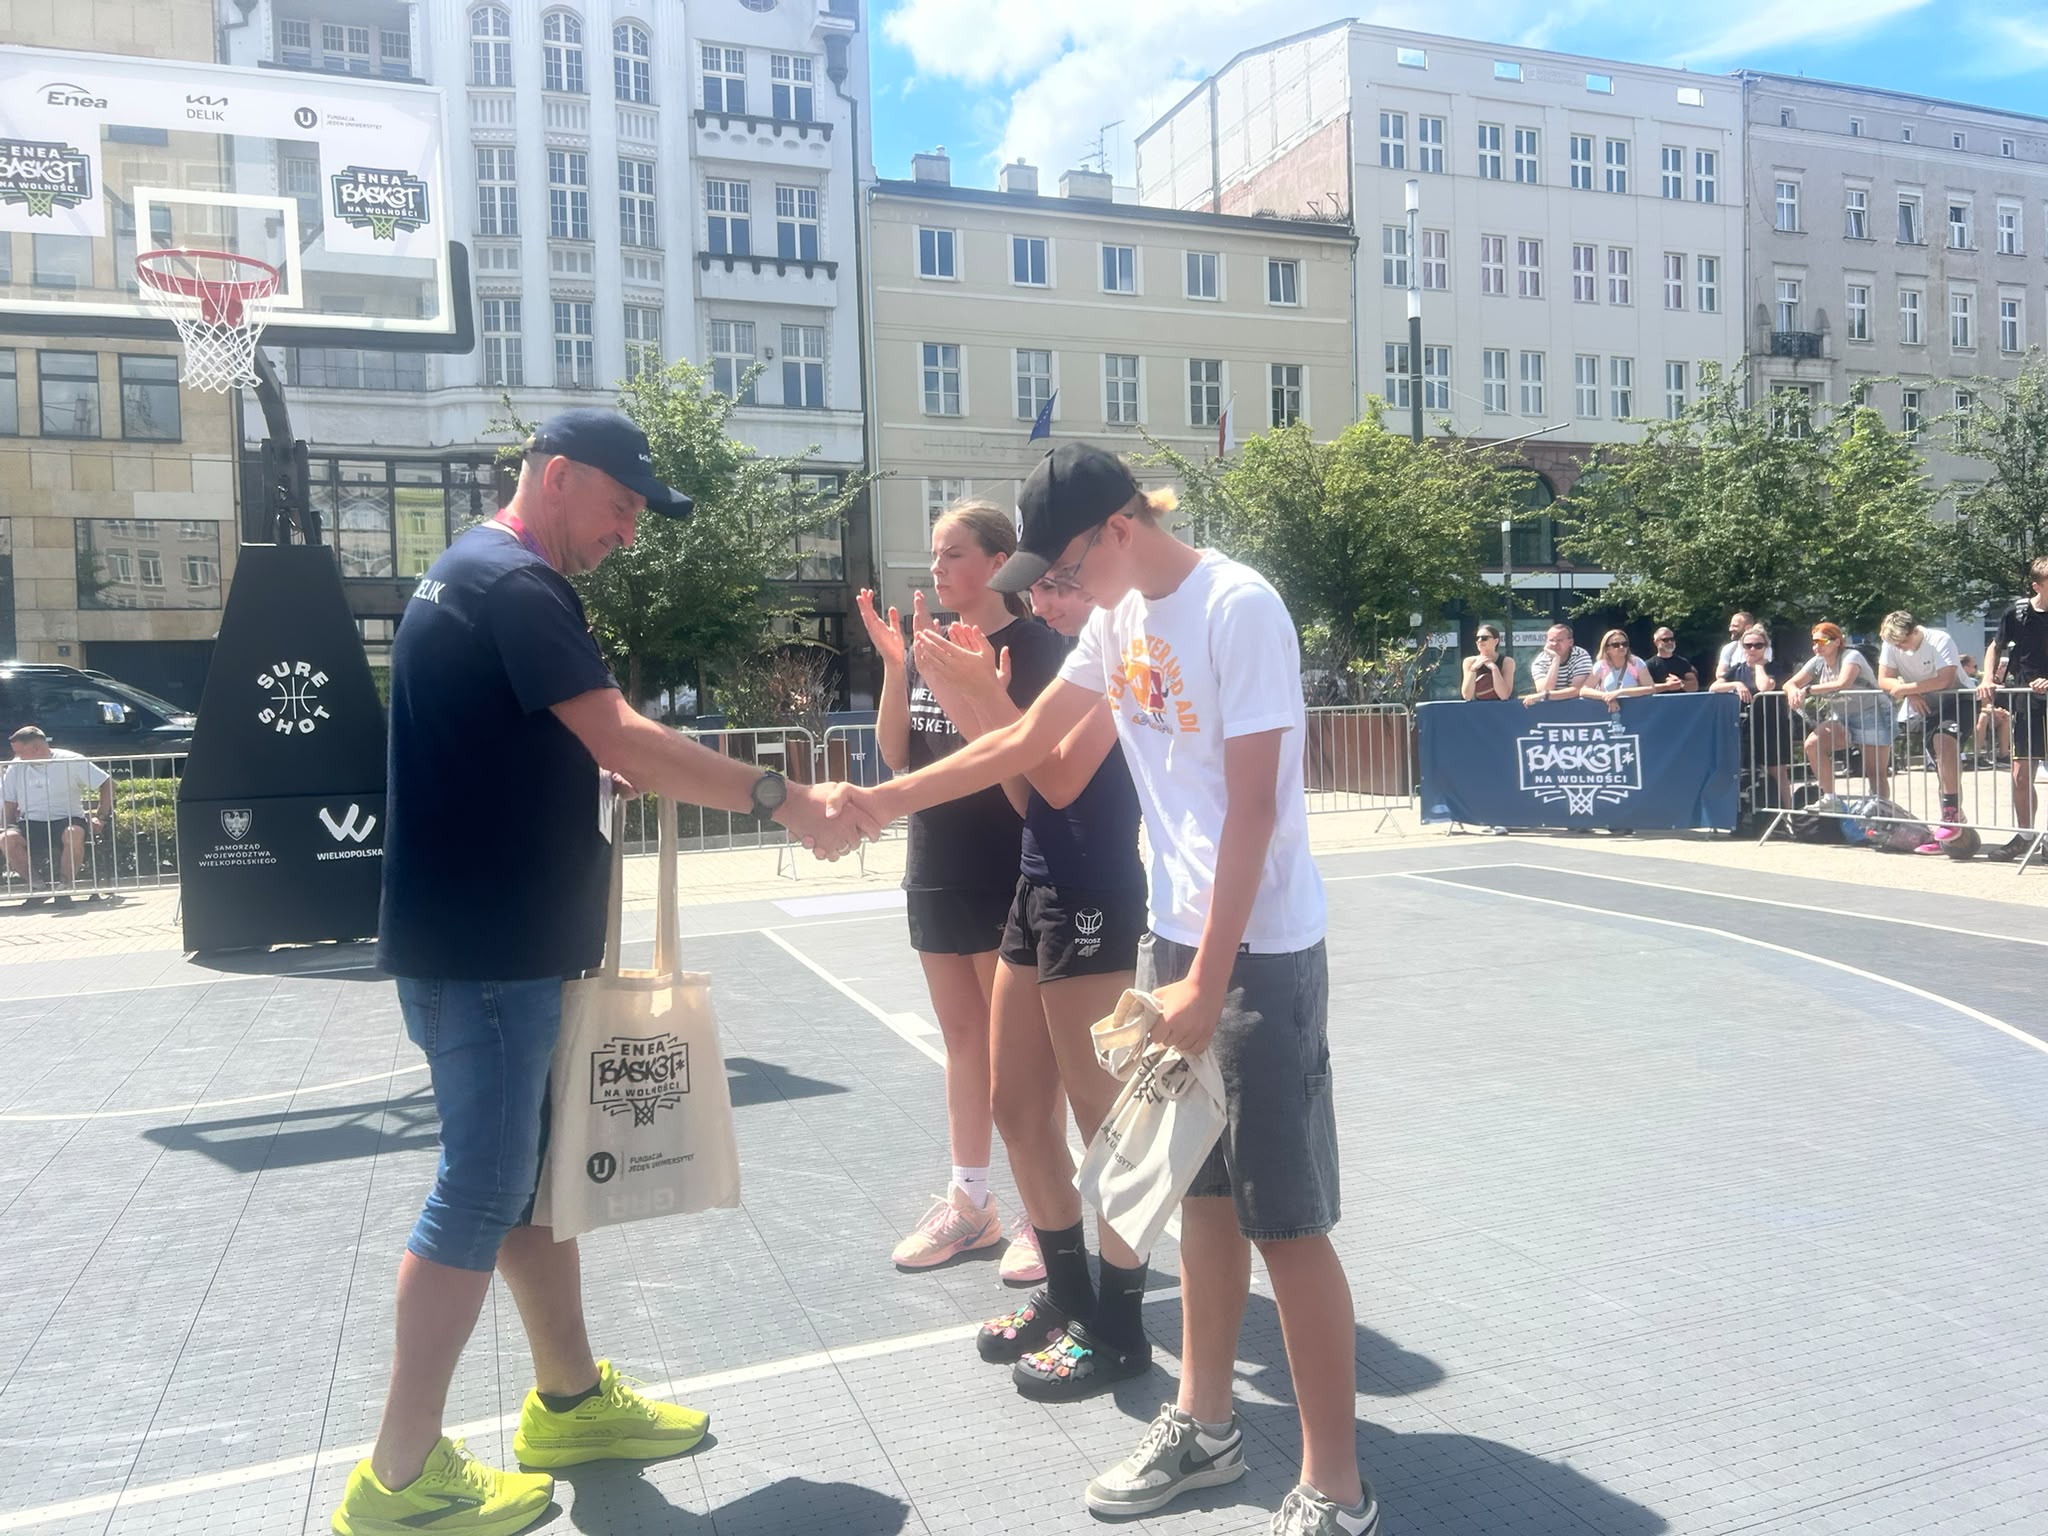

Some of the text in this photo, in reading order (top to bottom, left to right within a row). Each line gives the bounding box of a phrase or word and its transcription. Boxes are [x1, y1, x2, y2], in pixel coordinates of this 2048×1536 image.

[47, 91, 108, 109] Enea
[186, 108, 225, 121] DELIK
[11, 146, 61, 159] ENEA
[357, 173, 401, 186] ENEA
[18, 182, 79, 192] WOLNOŚCI
[365, 207, 418, 217] WOLNOŚCI
[257, 661, 329, 689] SURE
[258, 705, 331, 735] SHOT
[1548, 728, 1606, 742] ENEA
[1535, 773, 1627, 784] NA WOLNOŚCI
[214, 843, 261, 851] SAMORZĄD
[204, 850, 271, 859] WOJEWÓDZTWA
[316, 848, 384, 861] WIELKOPOLSKA
[199, 857, 277, 867] WIELKOPOLSKIEGO
[620, 1041, 666, 1057] ENEA
[604, 1089, 620, 1097] NA
